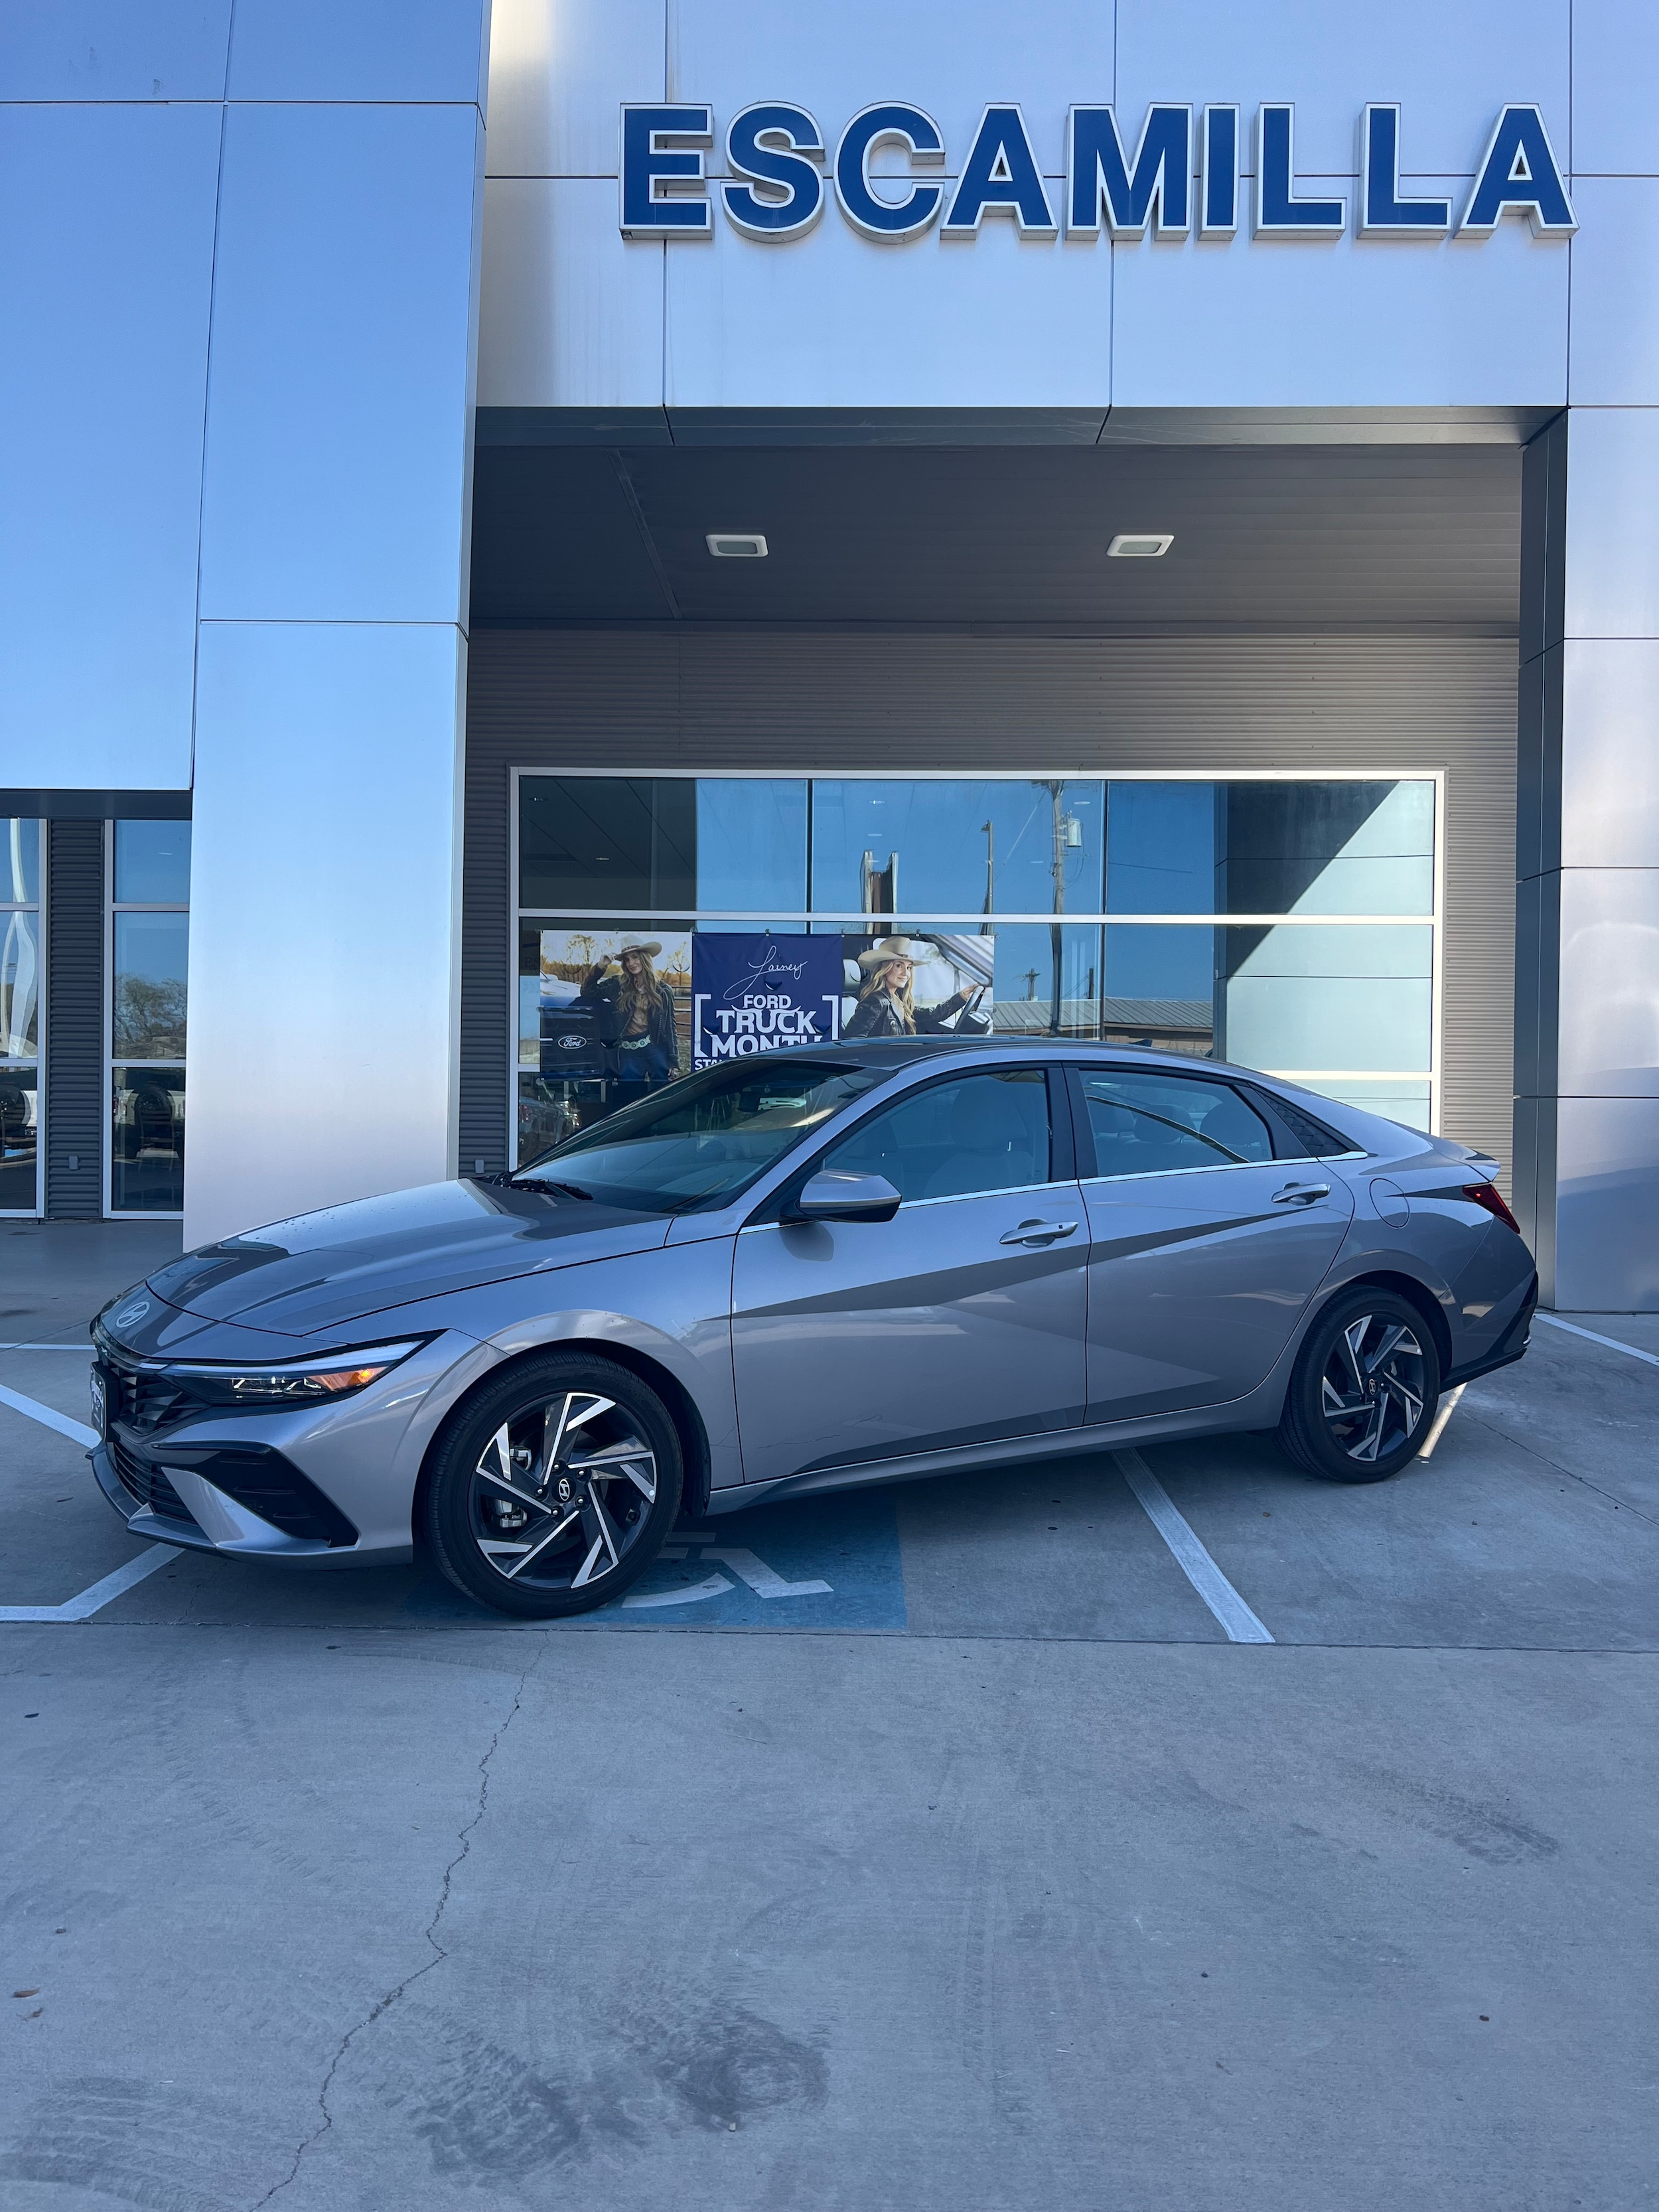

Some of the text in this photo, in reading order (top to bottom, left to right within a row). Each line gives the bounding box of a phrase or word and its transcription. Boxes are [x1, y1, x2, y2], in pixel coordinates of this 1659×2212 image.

[618, 100, 1581, 242] ESCAMILLA
[742, 994, 792, 1009] FORD
[715, 1008, 818, 1035] TRUCK
[563, 1037, 582, 1047] Ford
